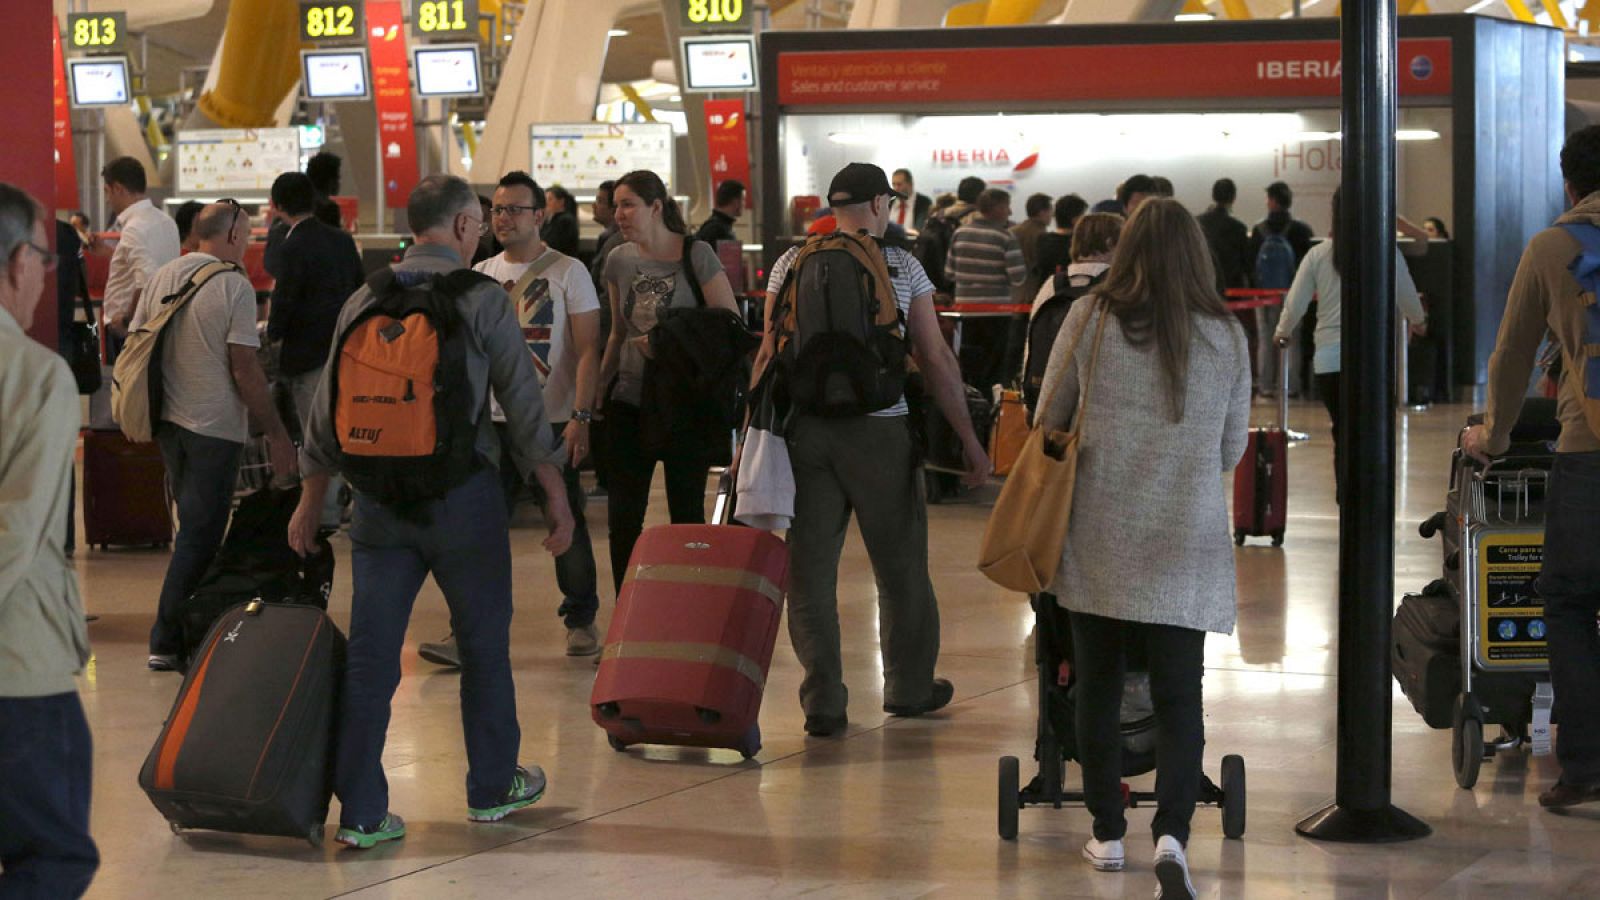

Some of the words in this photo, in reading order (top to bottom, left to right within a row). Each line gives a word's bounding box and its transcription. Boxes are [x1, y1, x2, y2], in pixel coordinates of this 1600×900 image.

[306, 5, 355, 37] 812
[419, 0, 467, 32] 811
[688, 0, 743, 23] 810
[74, 17, 117, 46] 813
[790, 63, 830, 78] Ventas
[791, 79, 819, 94] Sales
[821, 79, 843, 93] and
[844, 79, 897, 93] customer
[899, 79, 940, 92] service
[932, 149, 1010, 162] IBERIA
[1273, 140, 1341, 178] ¡Hol
[1508, 553, 1528, 562] Trolley
